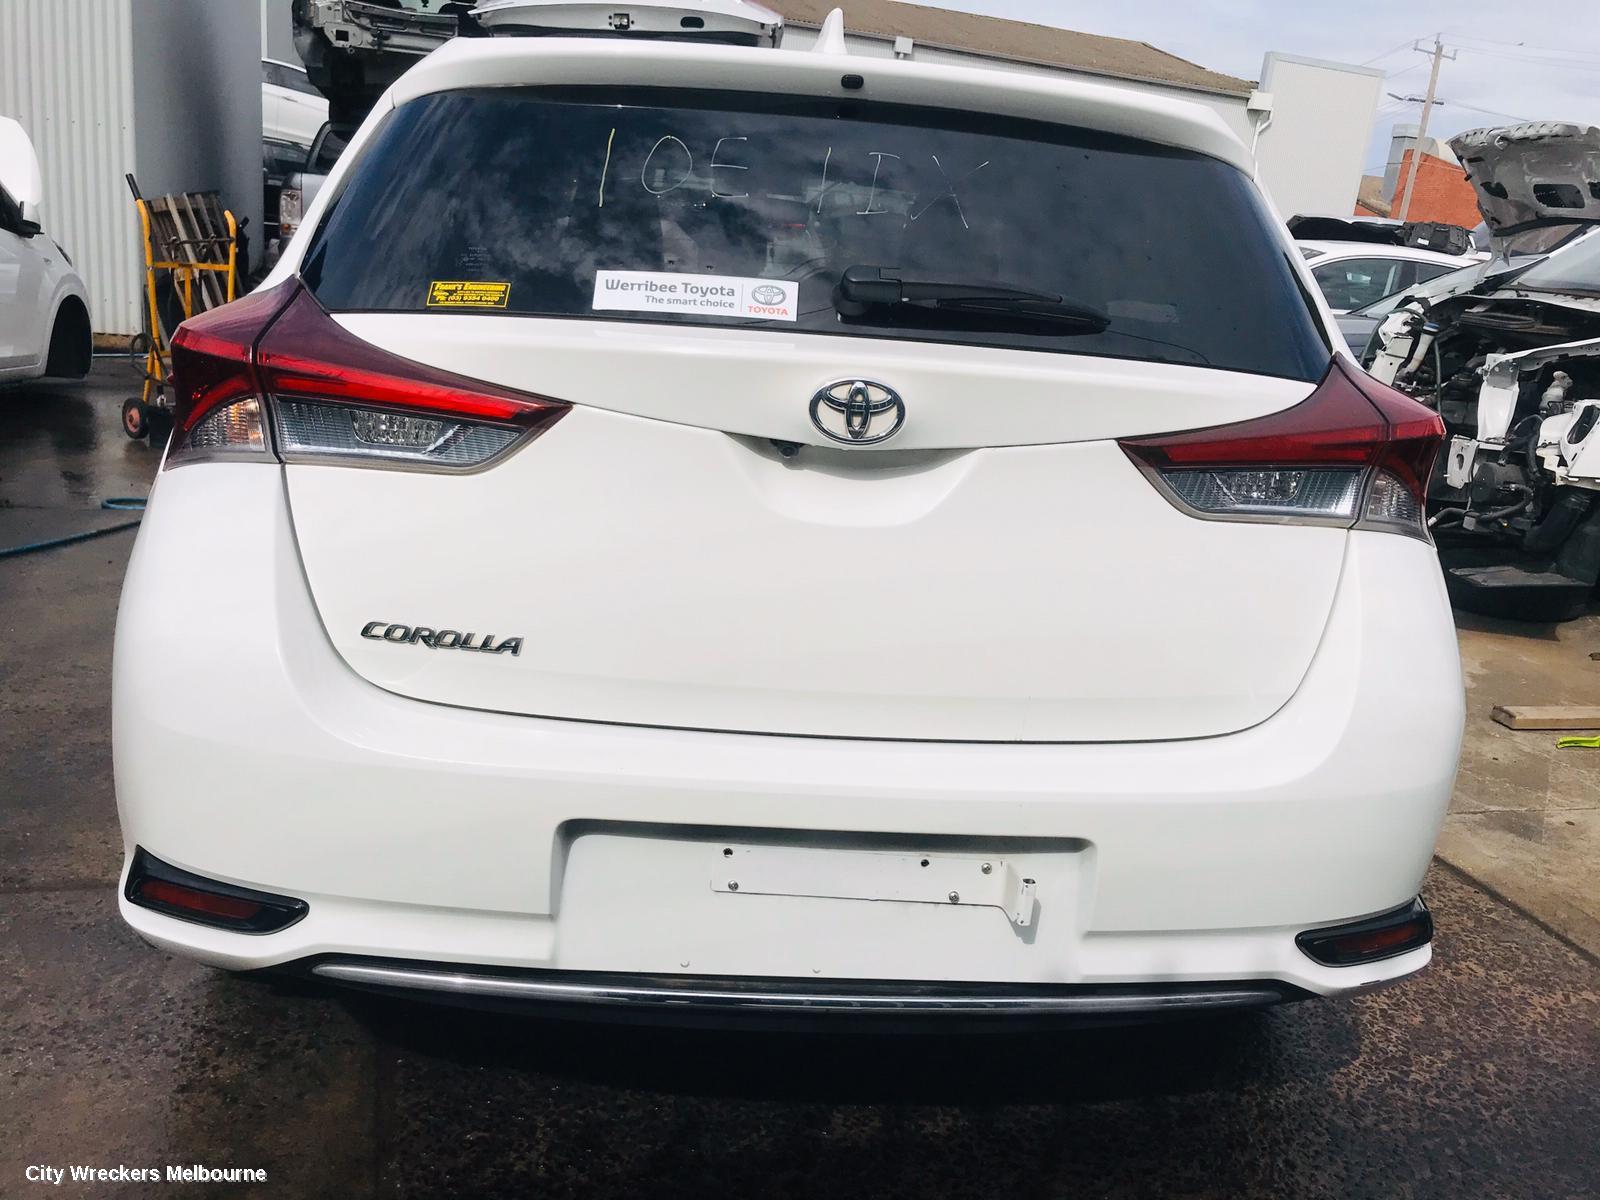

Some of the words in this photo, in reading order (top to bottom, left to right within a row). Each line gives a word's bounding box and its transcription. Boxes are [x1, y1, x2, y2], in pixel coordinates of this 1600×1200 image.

[605, 278, 678, 294] Werribee
[681, 282, 736, 297] Toyota
[645, 295, 663, 305] The
[666, 296, 698, 307] smart
[699, 298, 736, 309] choice
[747, 305, 789, 317] TOYOTA
[360, 621, 524, 657] COROLLA
